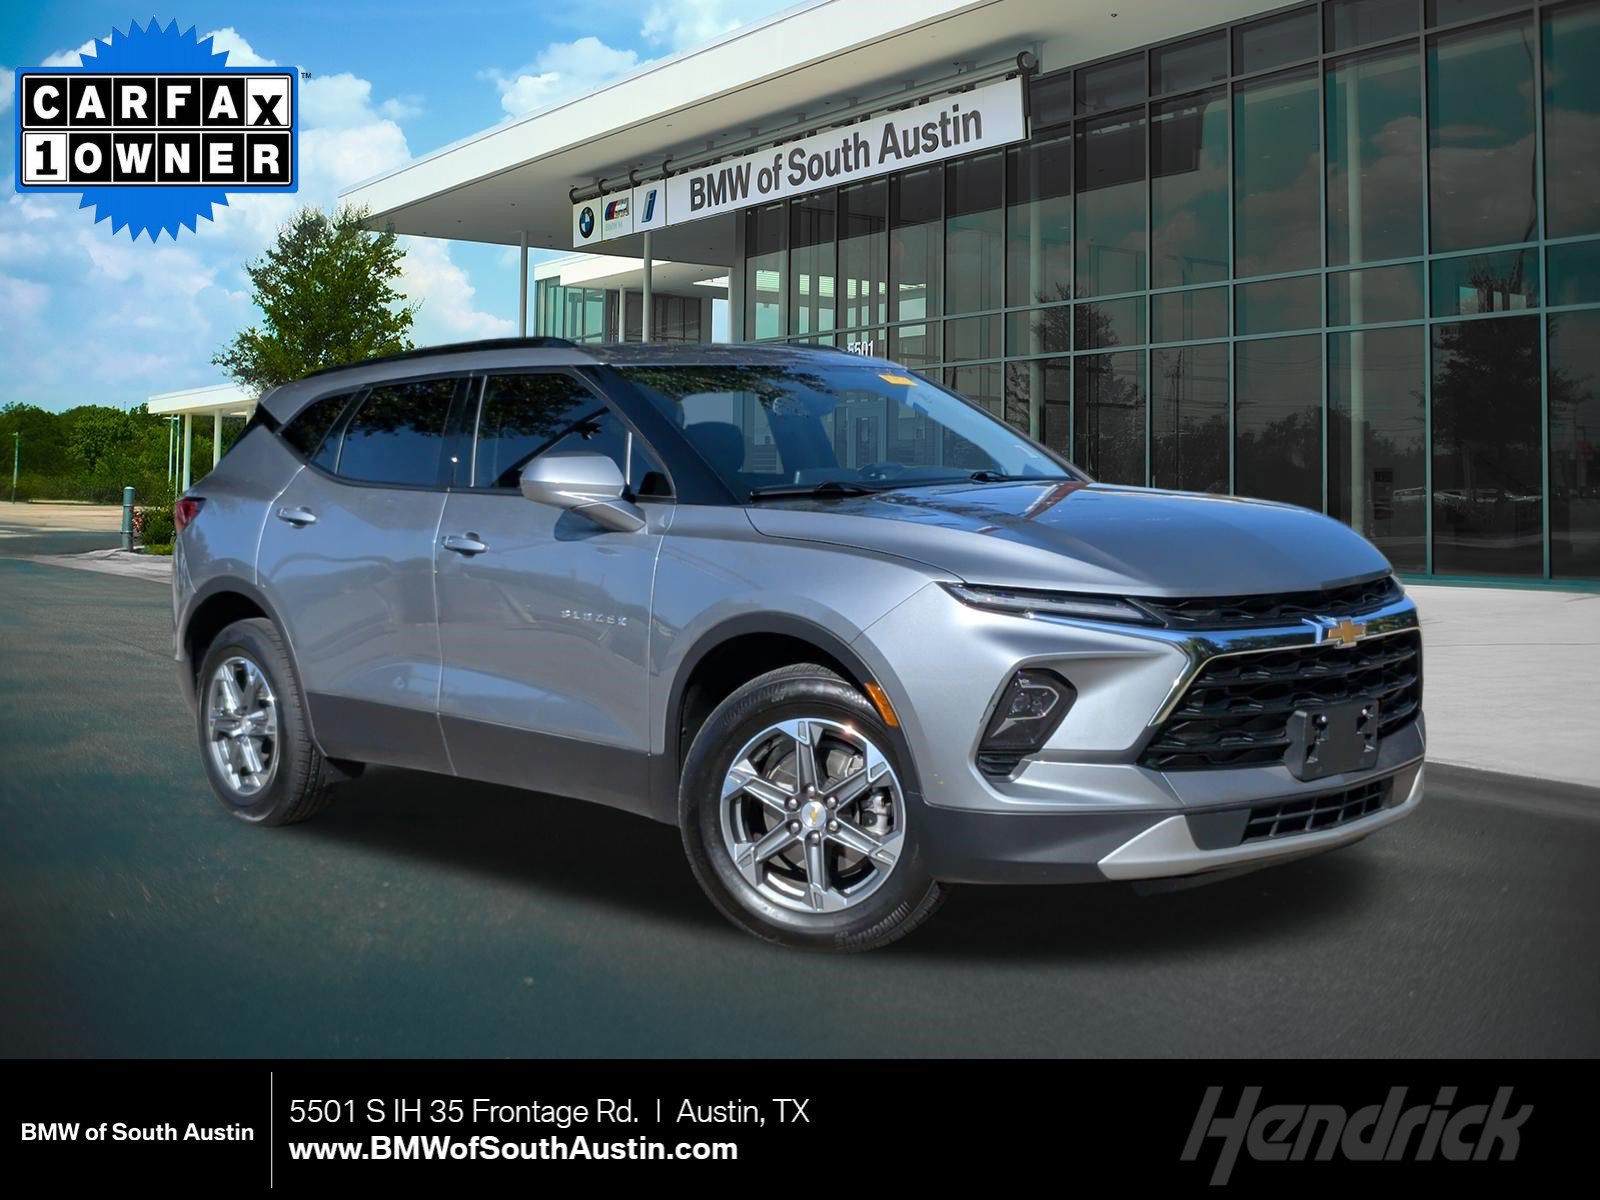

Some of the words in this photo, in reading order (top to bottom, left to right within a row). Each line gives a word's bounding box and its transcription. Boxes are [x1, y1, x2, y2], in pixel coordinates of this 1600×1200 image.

[690, 162, 751, 211] BMW
[757, 153, 783, 194] of
[787, 132, 870, 186] South
[878, 104, 982, 164] Austin
